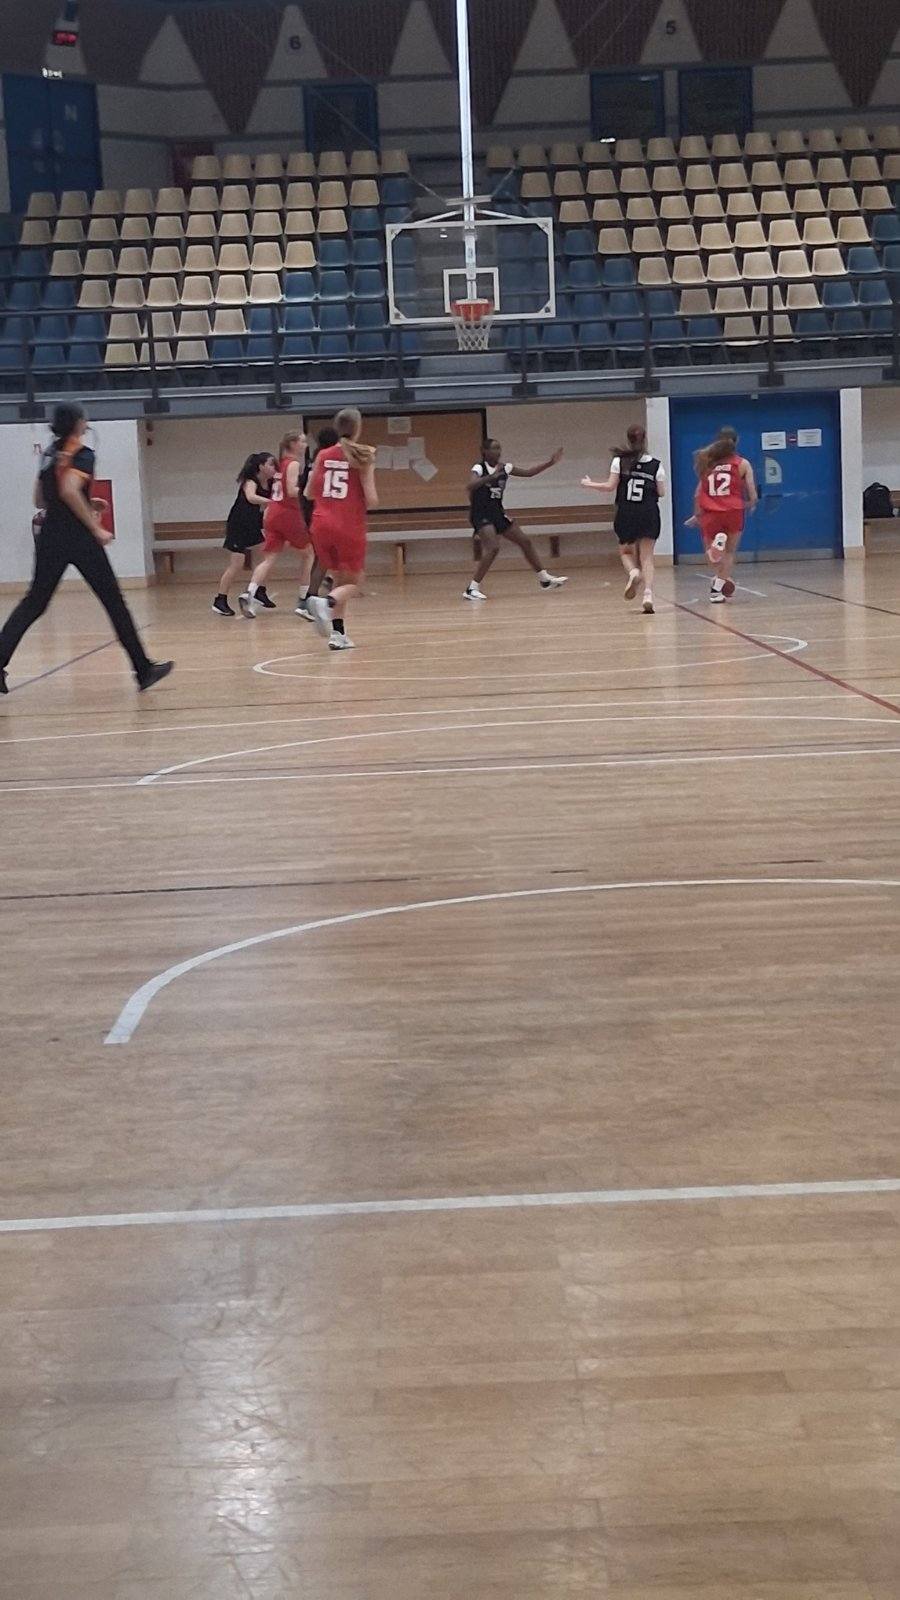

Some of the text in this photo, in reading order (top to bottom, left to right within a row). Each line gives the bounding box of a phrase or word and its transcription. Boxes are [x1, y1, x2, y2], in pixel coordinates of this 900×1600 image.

[667, 20, 677, 34] 5
[290, 36, 302, 51] 6
[322, 470, 350, 499] 15
[626, 479, 645, 502] 15
[707, 473, 732, 497] 12
